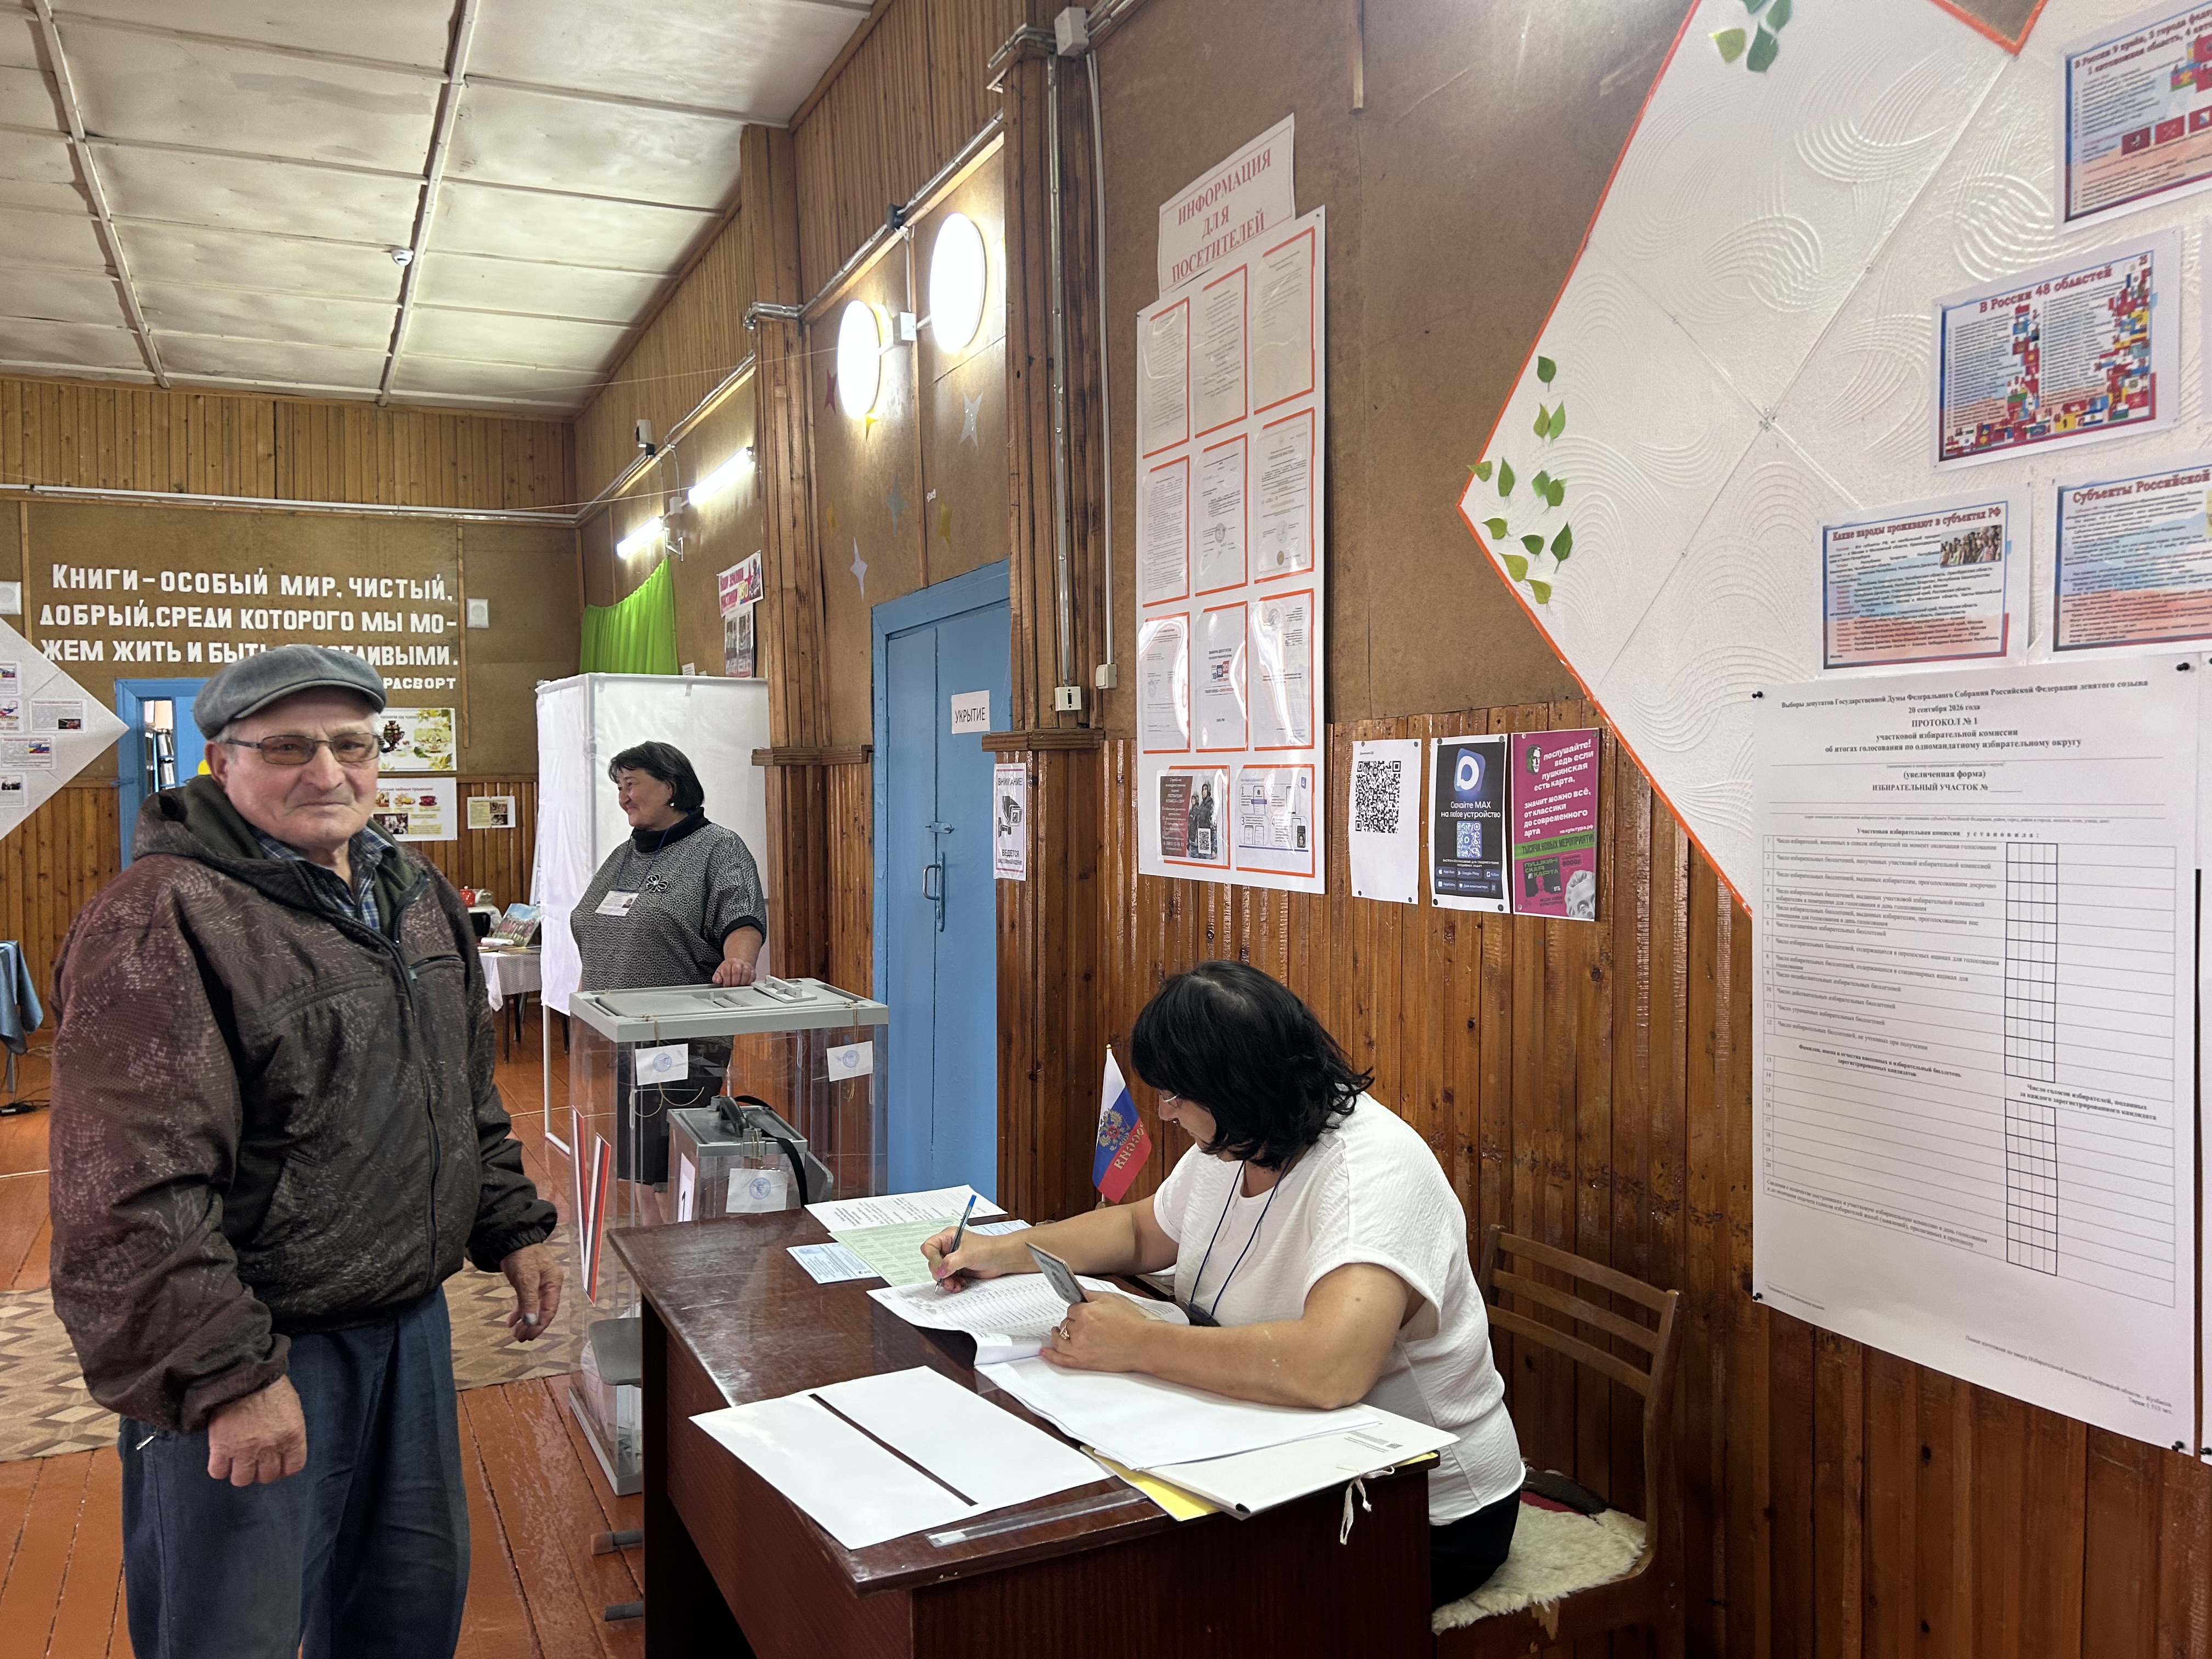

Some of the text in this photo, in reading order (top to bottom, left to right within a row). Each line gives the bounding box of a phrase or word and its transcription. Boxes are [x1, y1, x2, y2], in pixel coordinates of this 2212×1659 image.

[1178, 148, 1271, 226] ИНФОРМАЦИЯ
[1201, 205, 1229, 240] ДЛЯ
[1172, 208, 1265, 283] ПОСЕТИТЕЛЕЙ
[1979, 302, 1987, 313] В
[1991, 291, 2032, 310] России
[2054, 265, 2112, 292] областей
[2073, 471, 2211, 505] Субъекты Российской
[1833, 531, 1854, 541] Какие
[1857, 527, 1884, 538] народы
[1887, 519, 1933, 535] проживают
[1943, 510, 1986, 527] субъектах
[1988, 506, 2001, 518] РФ
[348, 574, 453, 601] ЧИСТЫЙ,
[240, 608, 354, 631] КОТОРОГО
[362, 612, 402, 632] МЫ
[410, 613, 457, 634] МО-
[41, 639, 104, 661] ЖЕМ
[112, 641, 182, 662] ЖИТЬ
[188, 642, 202, 662] И
[383, 677, 456, 689] РАСВОРТ
[1805, 699, 1834, 708] депутатов
[1835, 696, 1886, 706] Государственной
[1887, 695, 1906, 703] Думы
[1907, 692, 1953, 702] Федерального
[1955, 689, 1989, 698] Собрания
[1991, 686, 2034, 696] Российской
[2035, 684, 2078, 694] Федерации
[2079, 681, 2115, 690] девятого
[955, 707, 985, 724] УКРЫТИЕ
[1917, 704, 1947, 714] сентября
[1911, 718, 1961, 728] ПРОТОКОЛ
[1973, 717, 1978, 725] 1
[1876, 729, 2018, 742] участковой избирательной комиссии
[1543, 738, 1592, 760] послушайте!
[1825, 744, 1833, 753] об
[1859, 744, 1903, 752] голосования
[1915, 741, 1980, 751] одномандатному
[1982, 738, 2050, 749] избирательному
[2052, 738, 2081, 748] округу
[1554, 751, 1594, 766] ведь если
[1542, 763, 1588, 781] пушкинская
[1903, 769, 1986, 780] (увеличенная форма)
[1534, 776, 1576, 791] есть карта,
[1872, 782, 1938, 791] ИЗБИРАТЕЛЬНЫЙ
[1939, 783, 1978, 791] УЧАСТОК
[1524, 798, 1548, 809] значит
[1549, 792, 1572, 803] можно
[1464, 810, 1501, 819] устройство
[1533, 803, 1567, 816] классики
[1524, 809, 1588, 828] до современного
[1524, 828, 1541, 838] арта
